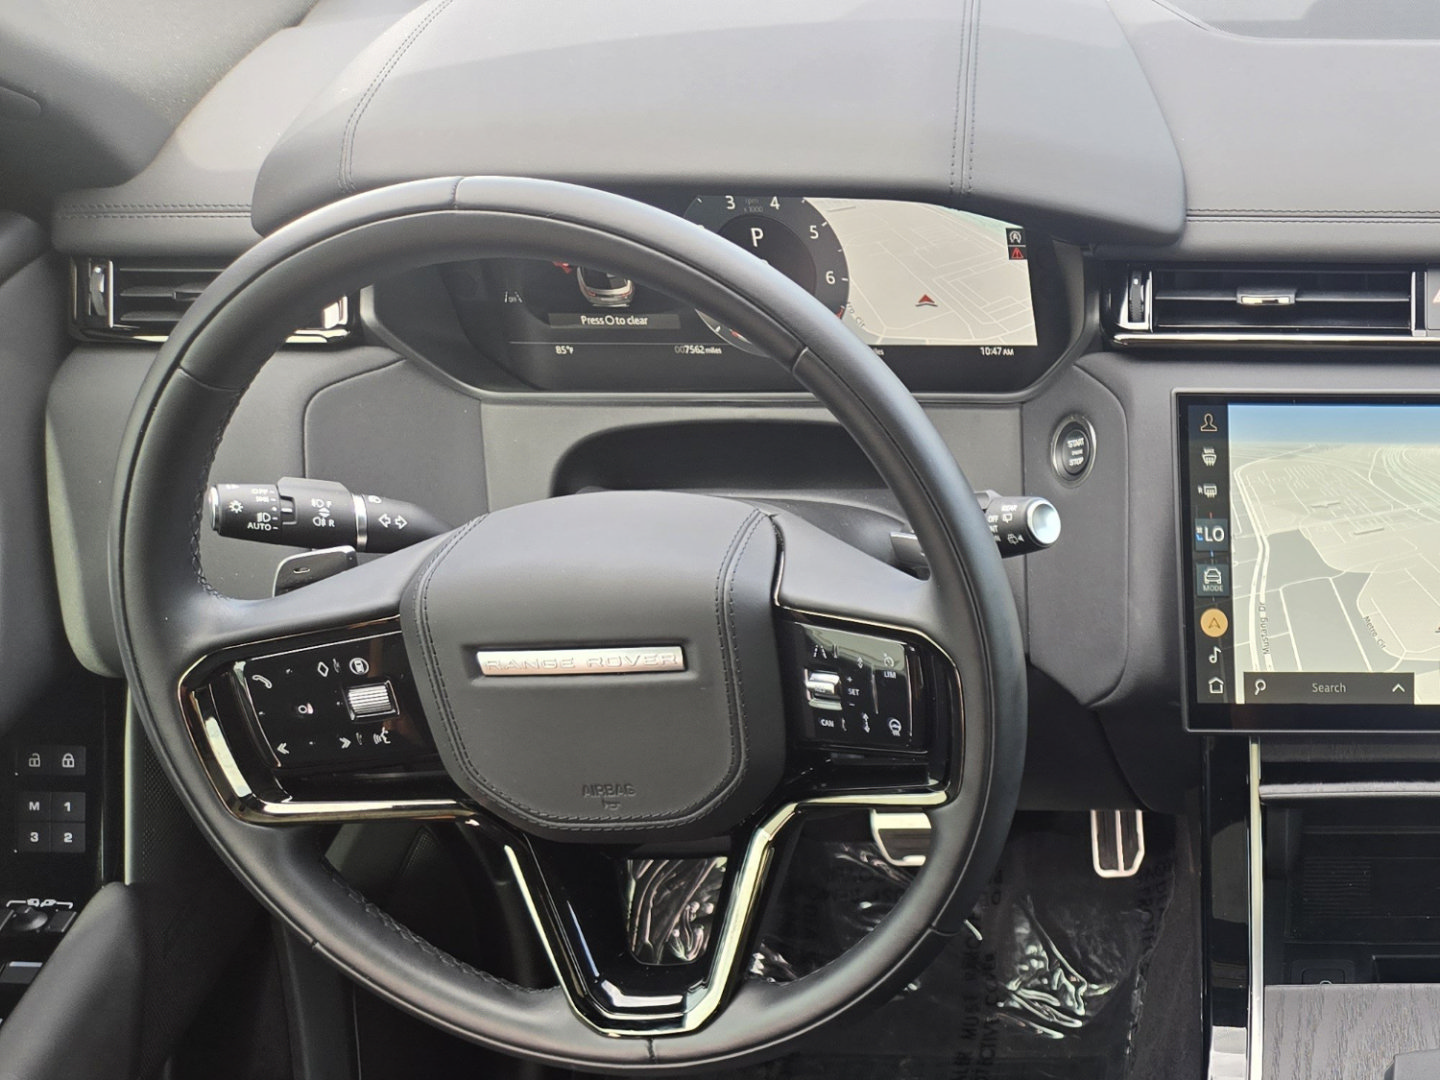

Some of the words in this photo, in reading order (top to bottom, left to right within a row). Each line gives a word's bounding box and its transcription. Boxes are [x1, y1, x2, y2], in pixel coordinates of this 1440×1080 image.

[725, 195, 736, 210] 3
[769, 196, 781, 210] 4
[751, 227, 764, 248] P
[809, 225, 820, 240] 5
[825, 271, 836, 285] 6
[580, 314, 604, 326] Press
[615, 316, 625, 326] to
[627, 314, 648, 326] clear
[980, 346, 1002, 357] 10:47
[1003, 348, 1014, 356] AM
[247, 522, 272, 531] AUTO
[1205, 526, 1225, 542] LO
[1203, 584, 1224, 593] MODE
[1364, 615, 1378, 638] Metro
[1259, 617, 1271, 655] Mustang
[484, 656, 577, 672] RANGE
[586, 652, 680, 670] ROVER
[847, 688, 860, 696] SET
[1311, 682, 1347, 693] Search
[820, 718, 835, 728] CAN
[582, 783, 637, 798] AIRBAG
[29, 801, 40, 811] M
[63, 801, 71, 812] 1
[30, 832, 39, 843] 3
[63, 832, 73, 843] 2
